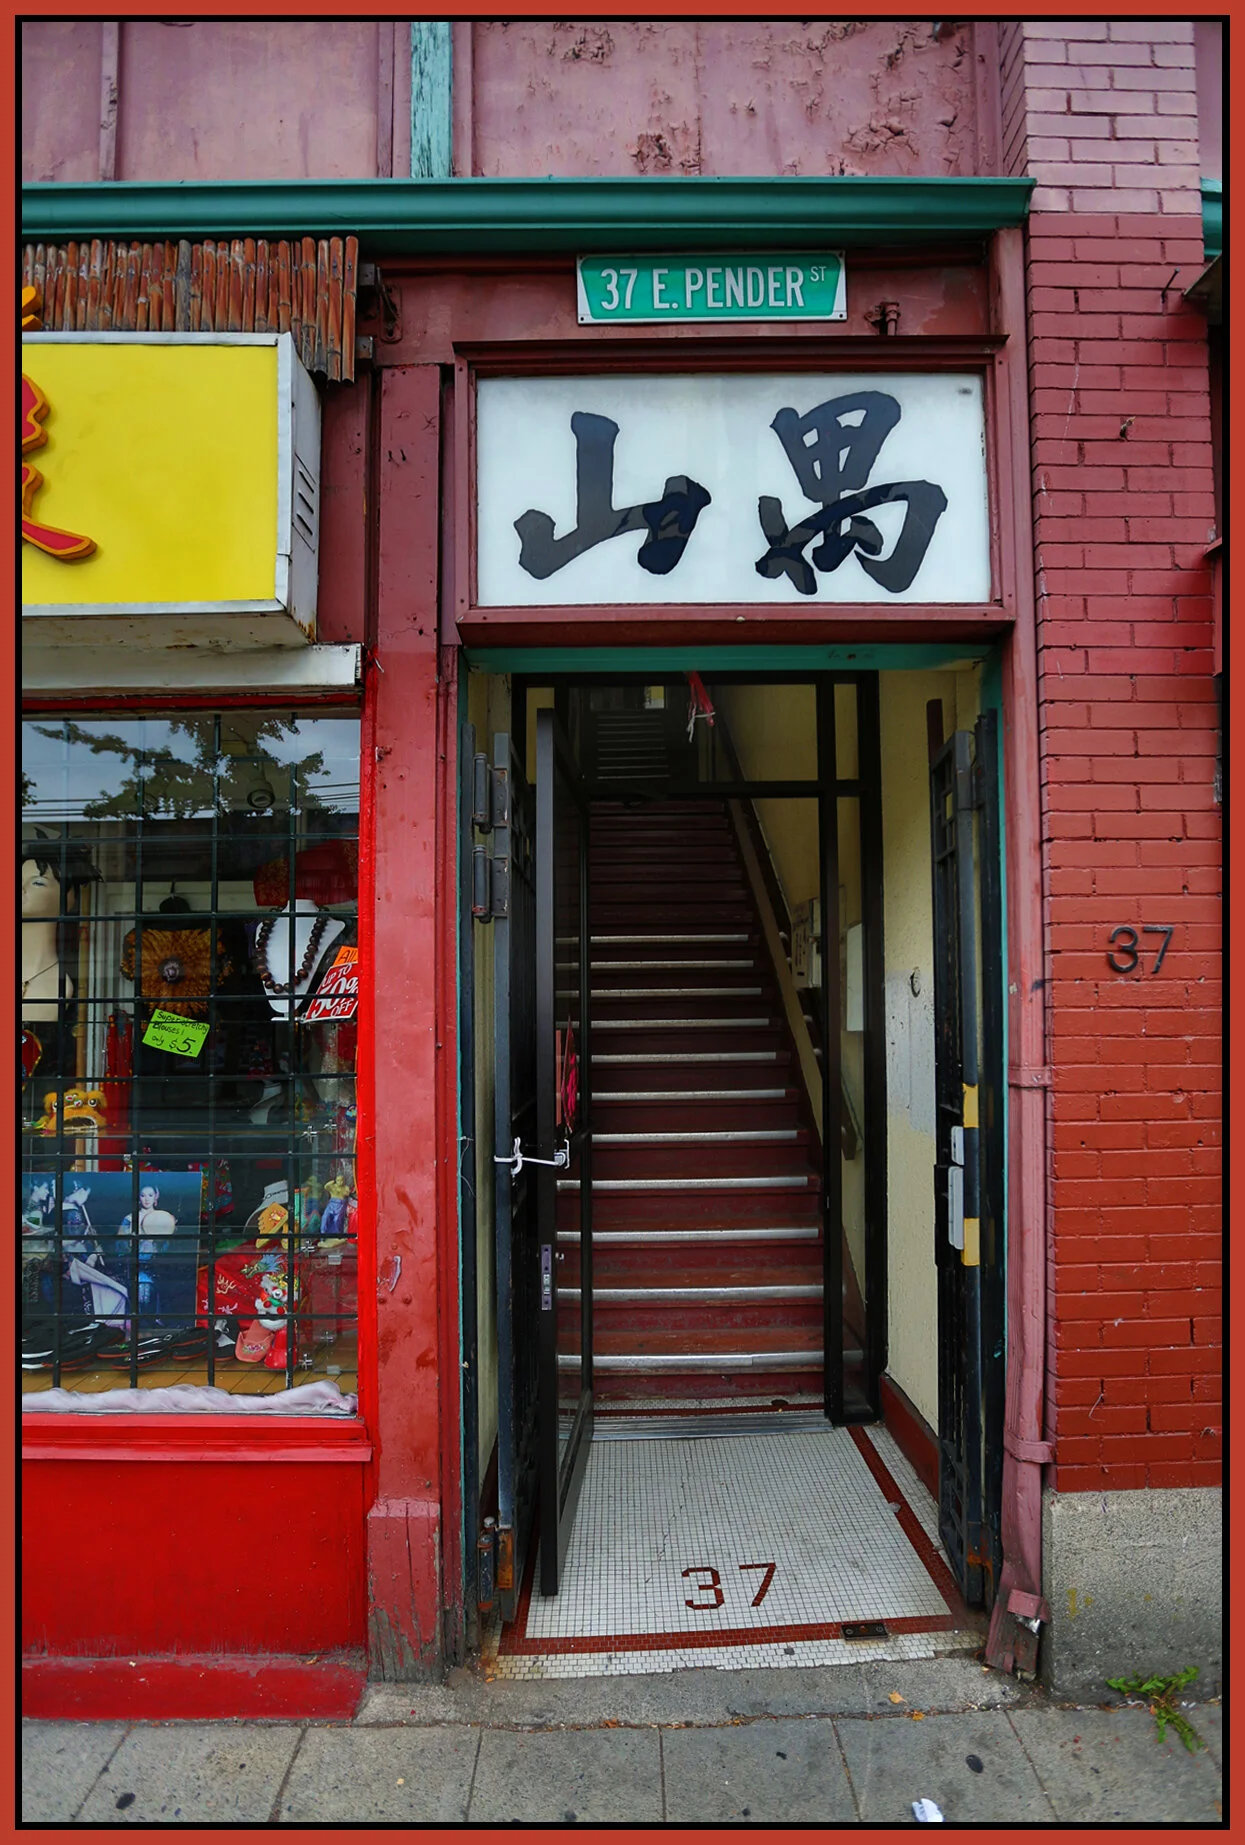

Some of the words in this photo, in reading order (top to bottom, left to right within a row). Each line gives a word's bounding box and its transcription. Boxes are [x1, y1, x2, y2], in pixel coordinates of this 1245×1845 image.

[600, 267, 639, 311] 37
[652, 268, 679, 310] E.
[685, 266, 805, 309] PENDER
[810, 265, 827, 282] ST
[1106, 925, 1175, 975] 37
[322, 971, 337, 987] UP
[337, 963, 353, 979] TO
[331, 997, 354, 1017] OFF
[681, 1562, 777, 1610] 37
